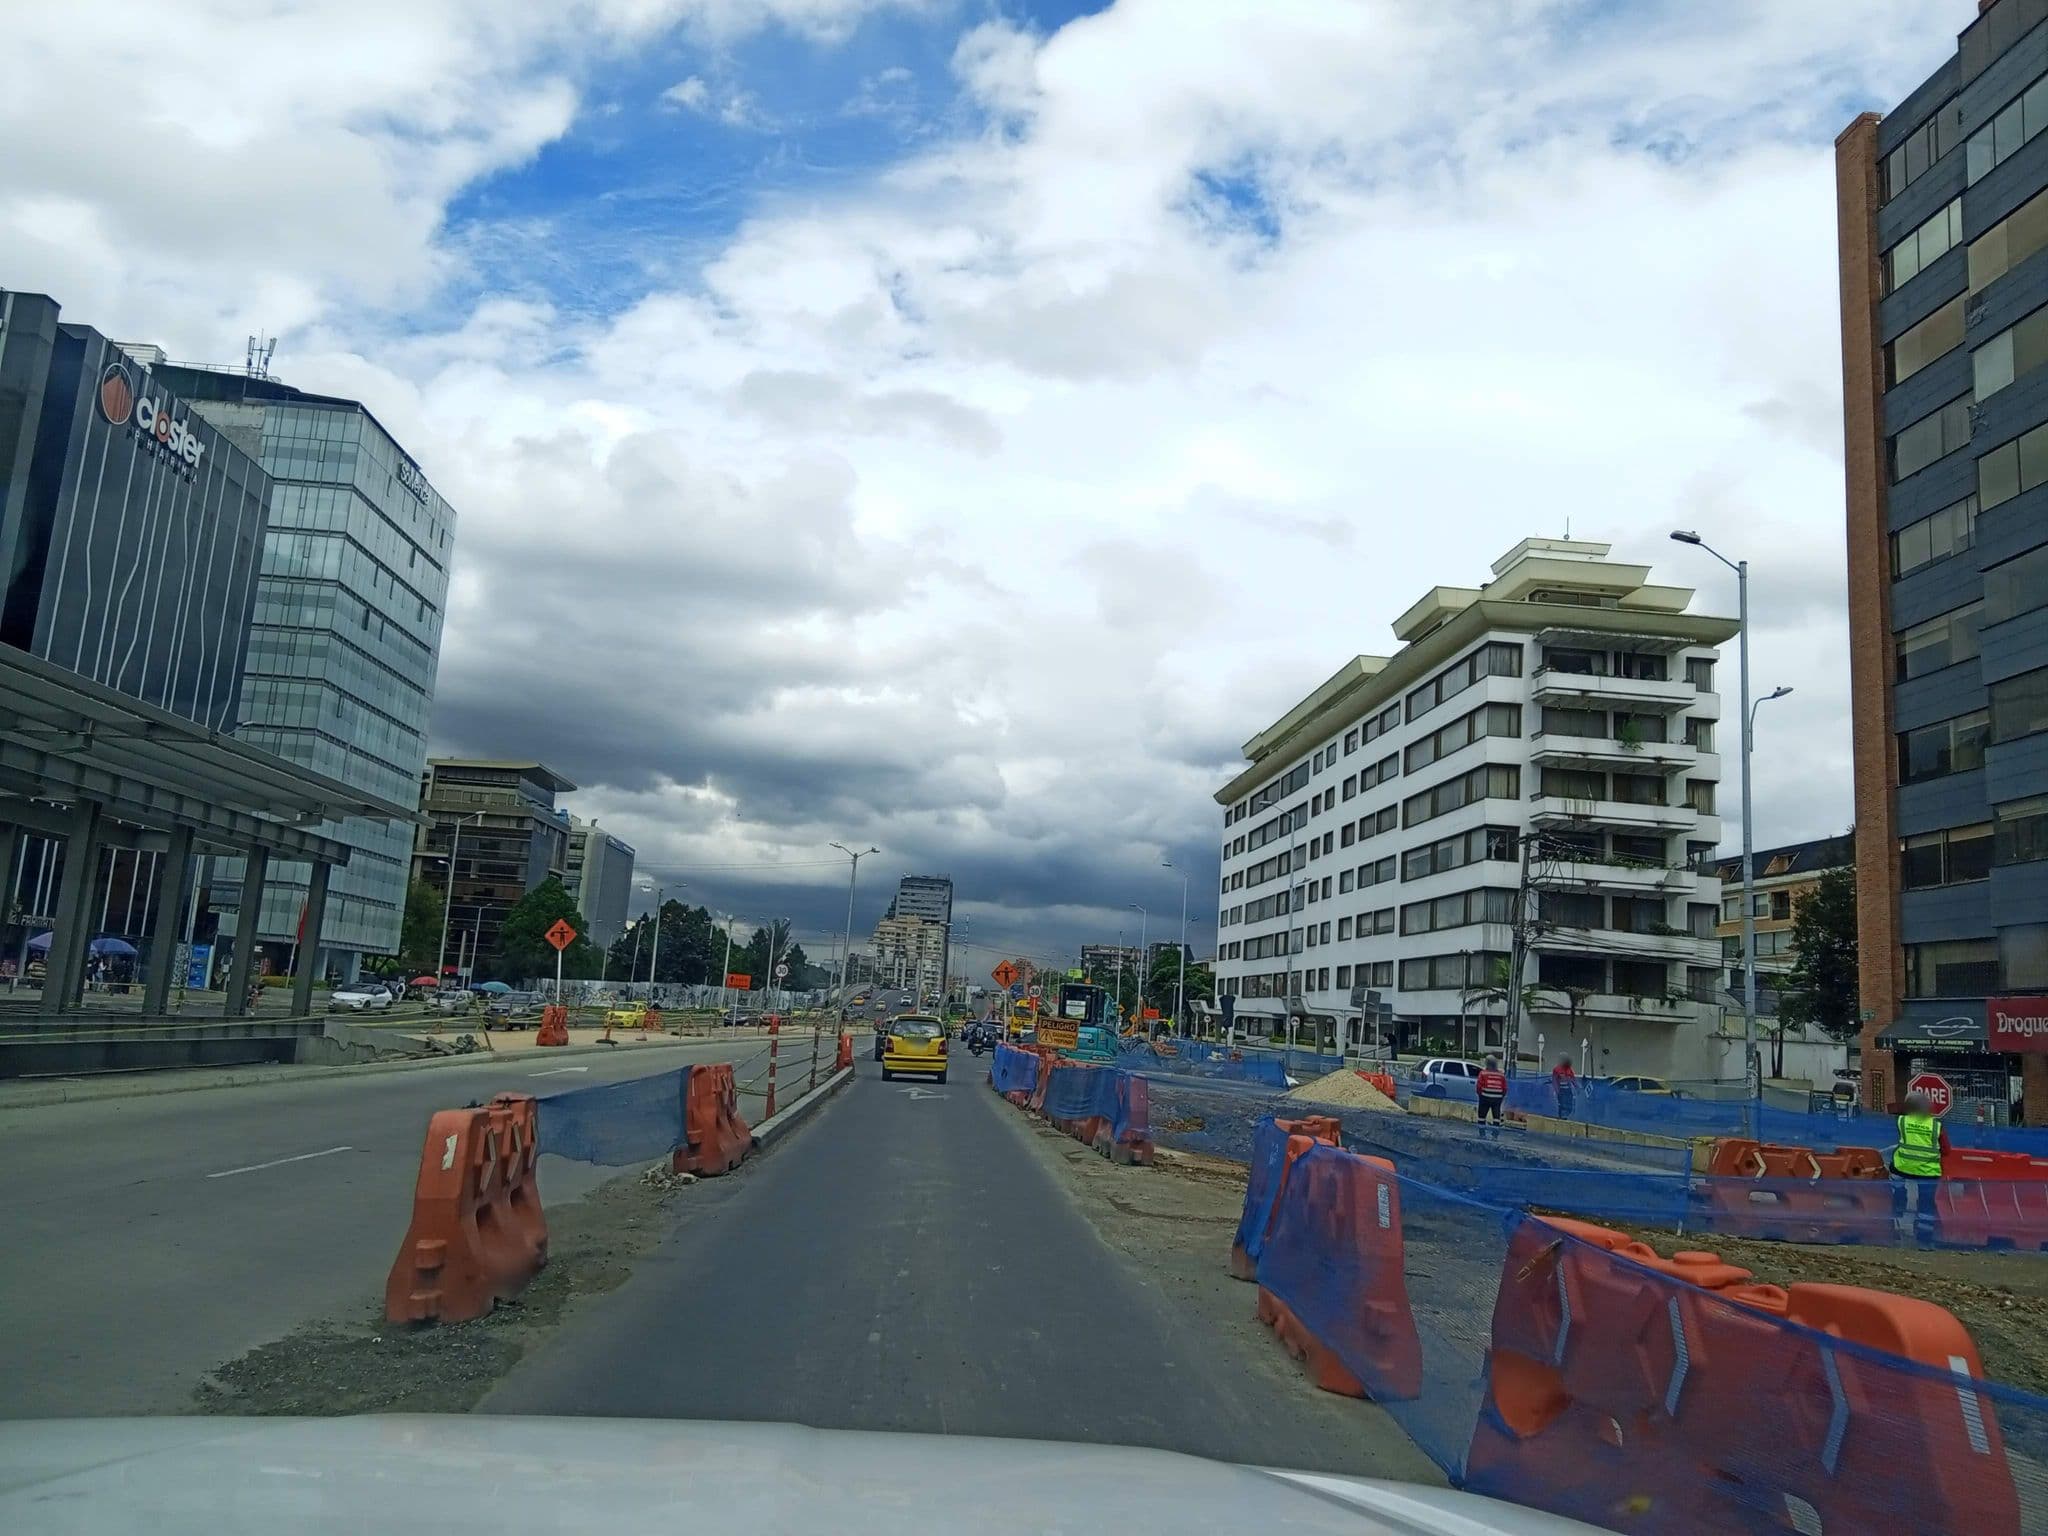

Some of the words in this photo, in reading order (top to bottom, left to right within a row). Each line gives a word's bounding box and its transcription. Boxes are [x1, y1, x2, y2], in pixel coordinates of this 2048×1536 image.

[134, 430, 198, 485] PHARMA
[136, 396, 206, 469] closter
[1042, 1019, 1076, 1032] PELIGRO
